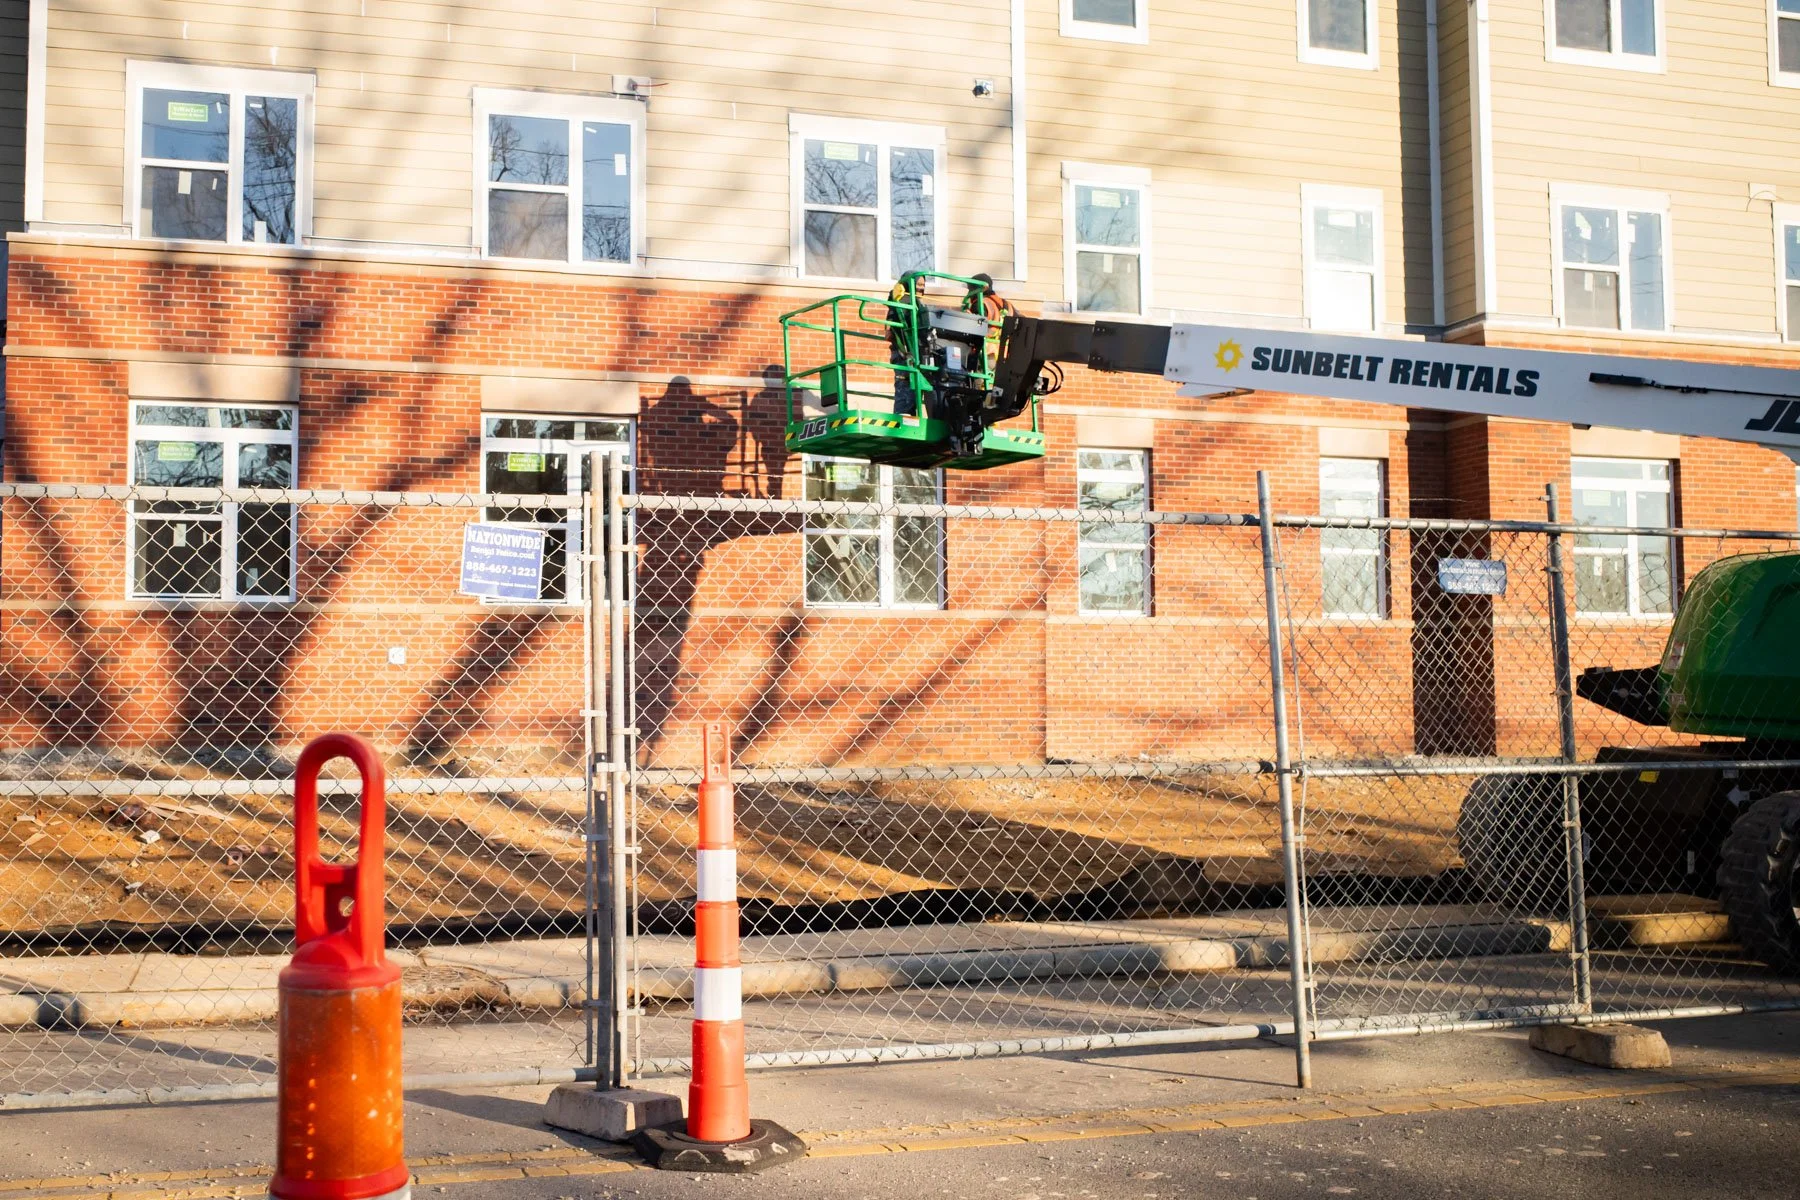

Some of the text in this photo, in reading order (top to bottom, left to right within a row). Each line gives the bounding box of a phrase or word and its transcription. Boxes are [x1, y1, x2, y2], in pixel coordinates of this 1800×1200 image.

[1251, 346, 1541, 398] SUNBELT RENTALS
[798, 418, 828, 441] JLG
[467, 530, 541, 550] NATIONWIDE
[465, 560, 537, 578] 888-467-1223
